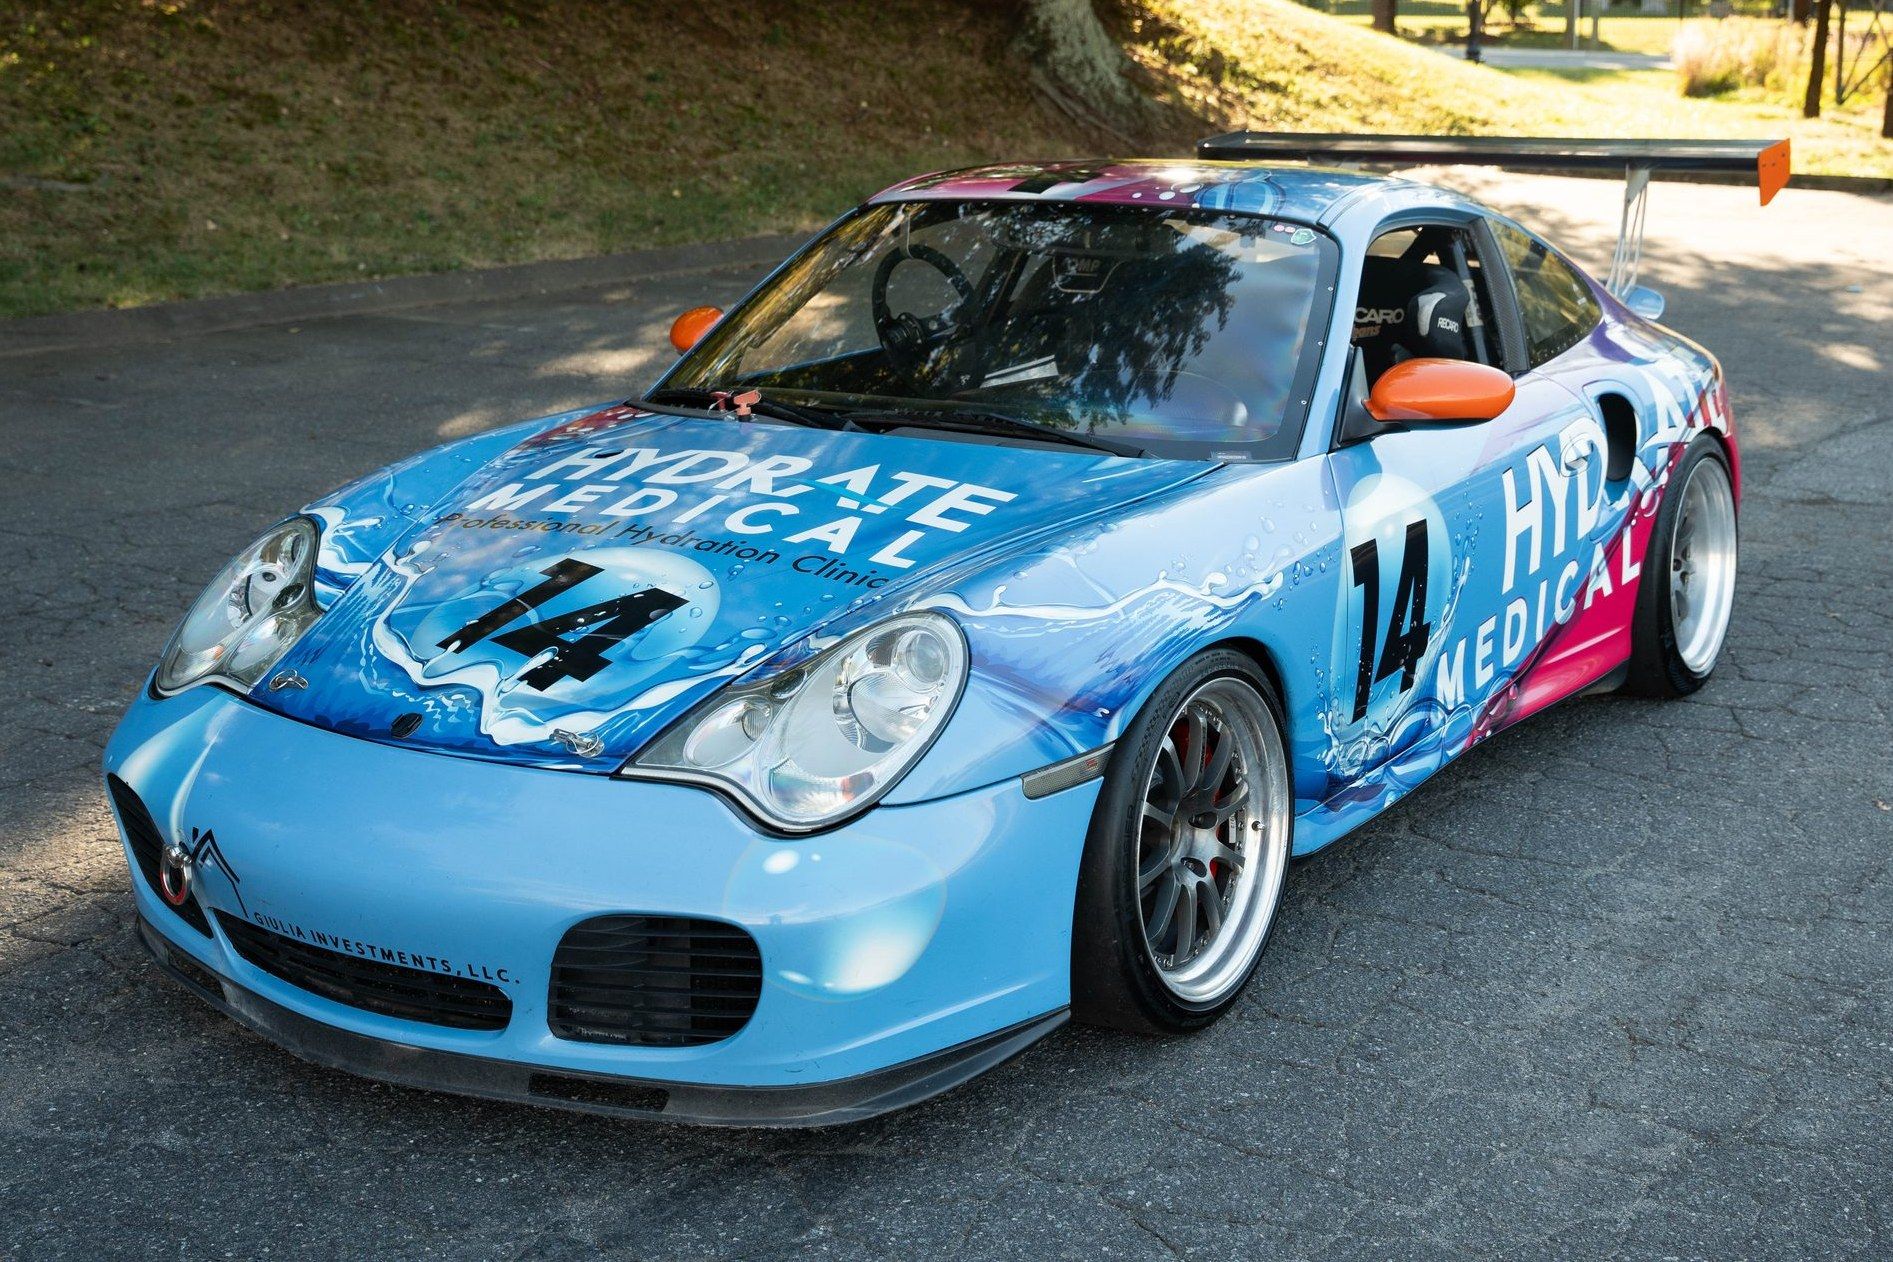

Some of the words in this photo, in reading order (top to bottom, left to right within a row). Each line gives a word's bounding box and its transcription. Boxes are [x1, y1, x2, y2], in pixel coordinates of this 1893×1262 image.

[1354, 306, 1405, 325] CARO
[1436, 316, 1460, 334] RECARO
[465, 483, 926, 569] MEDICAL
[530, 447, 1019, 533] HYDRATE
[437, 512, 616, 535] Professional
[617, 523, 780, 565] Hydration
[790, 555, 890, 590] Clinic
[435, 557, 690, 692] 14
[1350, 518, 1432, 725] 14
[1435, 527, 1641, 712] MEDICAL
[253, 911, 306, 940] GIULIA
[467, 963, 521, 985] LLC.
